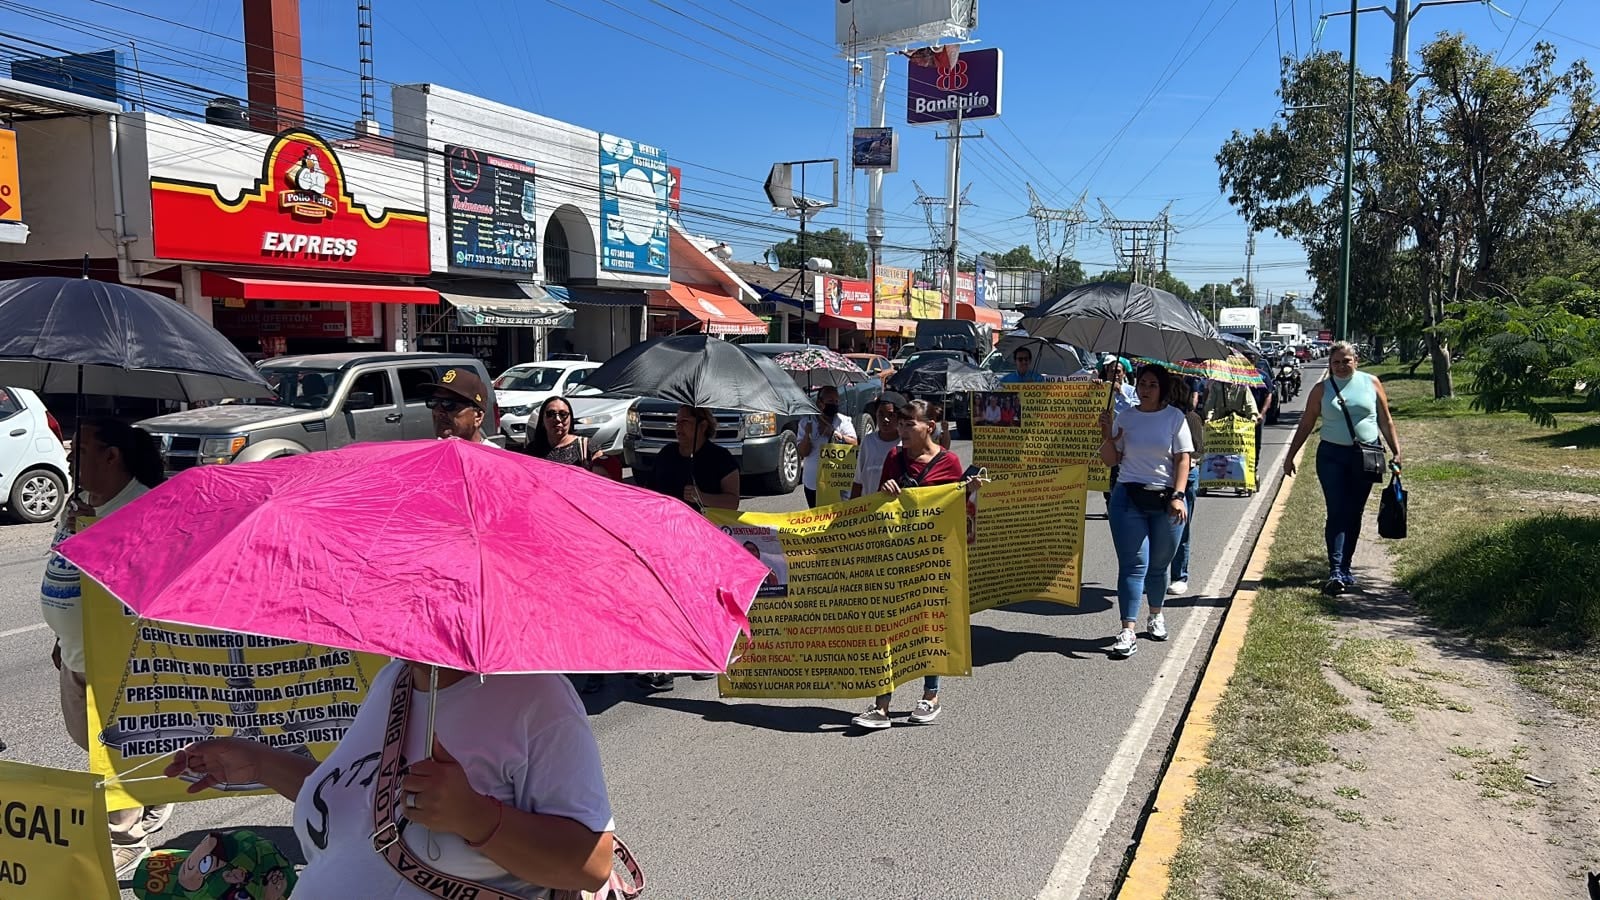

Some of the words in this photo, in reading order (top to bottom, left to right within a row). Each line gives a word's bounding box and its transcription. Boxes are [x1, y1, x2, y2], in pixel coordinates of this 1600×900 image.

[287, 193, 311, 202] Pollo
[312, 195, 333, 207] Feliz
[263, 231, 358, 258] EXPRESS
[820, 449, 846, 459] CASO
[991, 473, 1008, 481] CASO
[1038, 468, 1063, 477] LEGAL"
[787, 516, 813, 525] "CASO
[814, 510, 842, 522] PUNTO
[844, 503, 872, 516] LEGAL"
[800, 525, 816, 533] POR
[829, 518, 858, 529] "PODER
[859, 511, 900, 524] JUDICIAL"
[901, 510, 920, 519] QUE
[922, 507, 944, 517] HAS-
[803, 534, 846, 545] MOMENTO
[848, 530, 866, 539] NOS
[867, 527, 877, 536] HA
[878, 522, 935, 534] FAVORECIDO
[786, 549, 803, 557] CON
[804, 548, 818, 556] LAS
[819, 542, 864, 554] SENTENCIAS
[865, 537, 915, 550] OTORGADAS
[917, 535, 928, 544] AL
[930, 534, 947, 542] DE-
[789, 559, 830, 570] LINCUENTE
[831, 558, 840, 567] EN
[842, 557, 855, 566] LAS
[856, 553, 894, 565] PRIMERAS
[895, 548, 930, 560] CAUSAS
[932, 546, 945, 555] DE
[789, 570, 848, 582] INVESTIGACIÓN,
[849, 569, 874, 579] AHORA
[876, 568, 885, 576] LE
[887, 559, 951, 576] CORRESPONDE
[796, 587, 806, 595] LA
[807, 583, 838, 594] FISCALÍA
[840, 583, 863, 593] HACER
[864, 582, 883, 591] BIEN
[884, 581, 895, 590] SU
[897, 573, 936, 588] TRABAJO
[938, 572, 951, 580] EN
[794, 599, 817, 609] SOBRE
[819, 599, 827, 608] EL
[829, 597, 868, 607] PARADERO
[870, 596, 880, 605] DE
[882, 589, 921, 604] NUESTRO
[922, 586, 948, 595] DINE-
[748, 615, 762, 624] ARA
[764, 614, 773, 623] LA
[774, 612, 821, 623] REPARACIÓN
[822, 612, 836, 620] DEL
[837, 610, 860, 620] DAÑO
[861, 610, 867, 619] Y
[868, 610, 885, 619] QUE
[887, 608, 897, 617] SE
[899, 602, 922, 614] HAGA
[141, 627, 177, 645] GENTE
[179, 634, 193, 645] EL
[195, 634, 244, 648] DINERO
[132, 659, 150, 674] LA
[153, 658, 191, 675] GENTE
[193, 663, 211, 676] NO
[213, 664, 254, 678] PUEDE
[256, 657, 317, 677] ESPERAR
[319, 651, 350, 668] MÁS
[730, 668, 753, 677] MENTE
[754, 668, 804, 677] SENTANDOSE
[804, 668, 810, 677] Y
[811, 667, 857, 676] ESPERANDO.
[859, 659, 898, 676] TENEMOS
[899, 653, 916, 663] QUE
[917, 648, 951, 658] LEVAN-
[731, 681, 757, 690] TARNOS
[758, 681, 764, 690] Y
[764, 681, 794, 690] LUCHAR
[796, 681, 812, 690] POR
[838, 681, 854, 690] "NO
[855, 679, 877, 690] MÁS
[878, 660, 935, 687] CORUPCIÓN".
[126, 685, 209, 702] PRESIDENTA
[211, 687, 283, 702] ALEJANDRA
[284, 677, 359, 698] GUTIÉRREZ,
[118, 716, 138, 731] TU
[140, 713, 197, 730] PUEBLO,
[198, 713, 224, 727] TUS
[226, 712, 285, 728] MUJERES
[286, 710, 297, 723] Y
[297, 706, 325, 720] TUS
[327, 701, 361, 718] NIÑO
[386, 664, 411, 747] BIMBA
[258, 731, 304, 747] HAGAS
[377, 758, 397, 828] LOLA
[0, 801, 86, 847] GAL"
